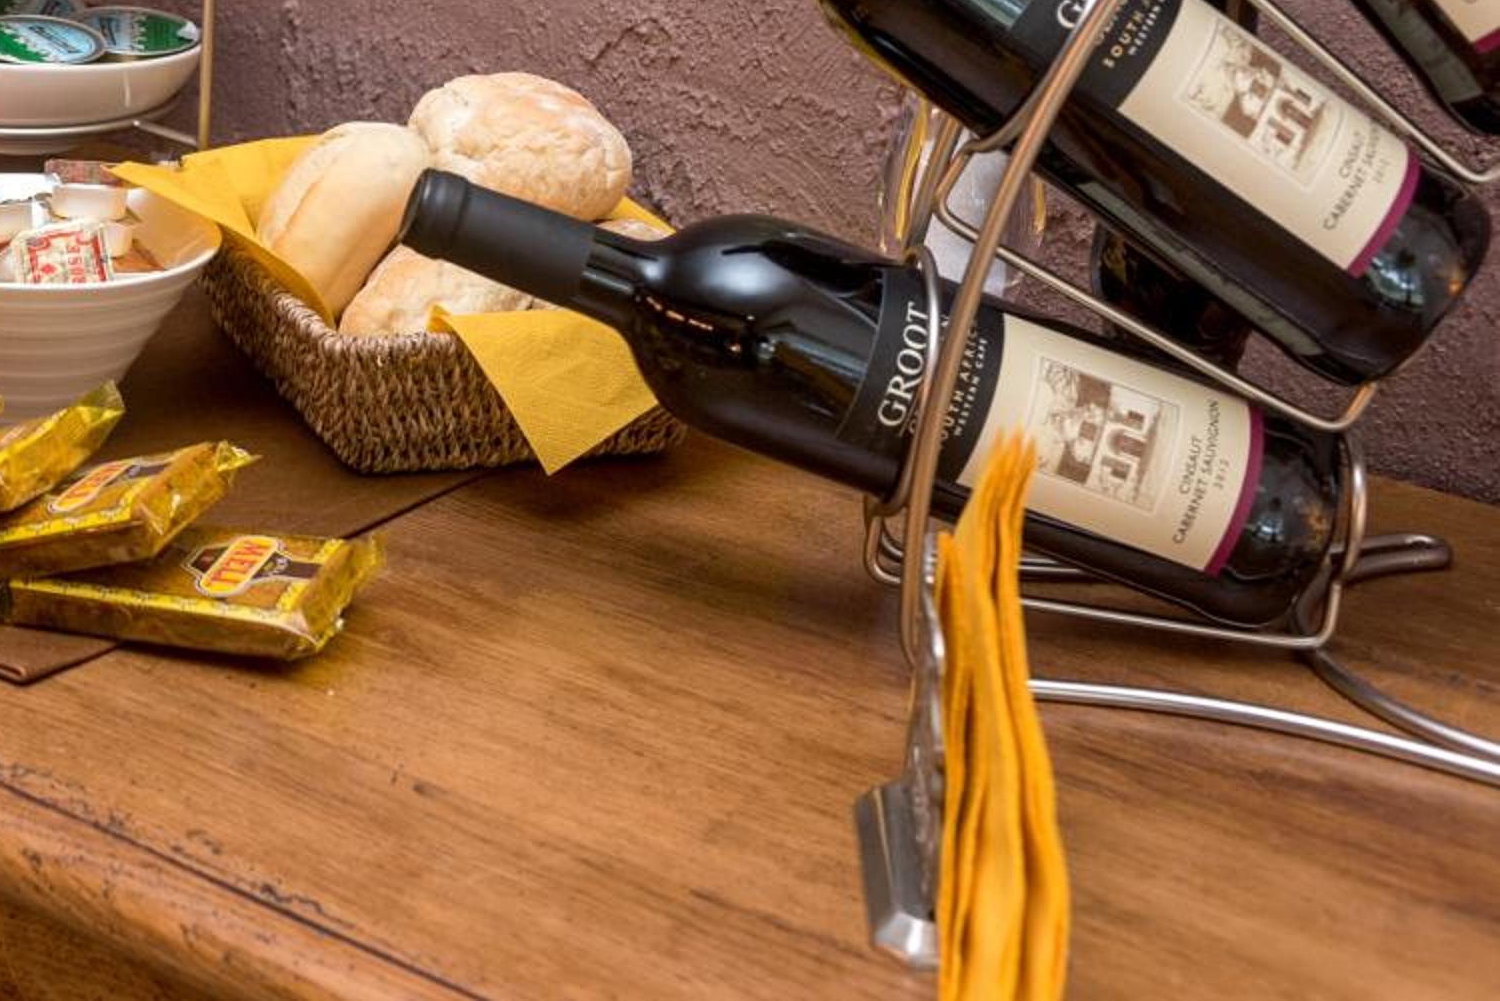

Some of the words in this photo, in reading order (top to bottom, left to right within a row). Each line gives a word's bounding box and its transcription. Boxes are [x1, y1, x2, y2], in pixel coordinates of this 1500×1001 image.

[877, 301, 929, 429] GROOT
[1172, 475, 1208, 545] CABERNET
[1200, 399, 1221, 476] SAUVIGNON
